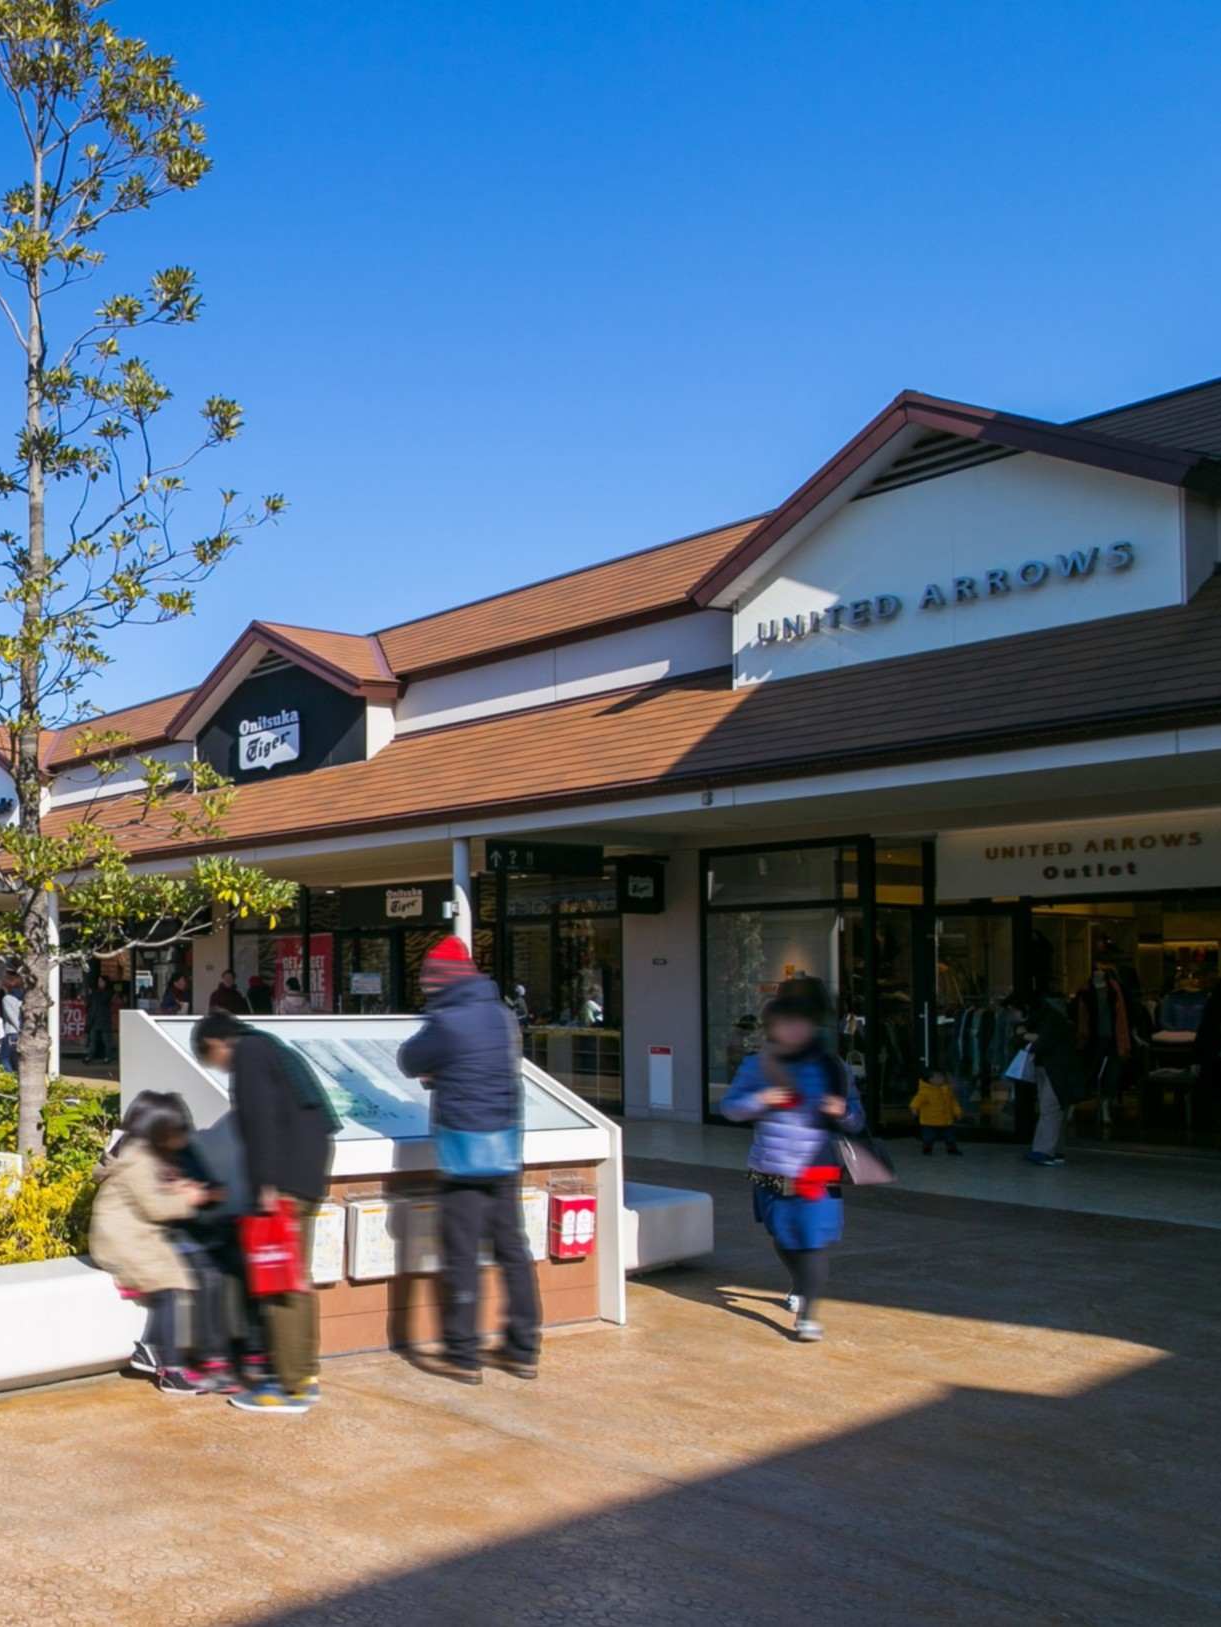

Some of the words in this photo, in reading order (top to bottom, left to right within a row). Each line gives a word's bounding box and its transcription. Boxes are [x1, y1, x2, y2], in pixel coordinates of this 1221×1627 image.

[757, 594, 904, 643] UNITED
[919, 541, 1136, 611] ARROWS
[239, 709, 298, 735] Onitsuka
[246, 731, 291, 762] Tiger
[984, 841, 1073, 860] UNITED
[1083, 832, 1204, 853] ARROWS
[1042, 861, 1138, 880] Outlet
